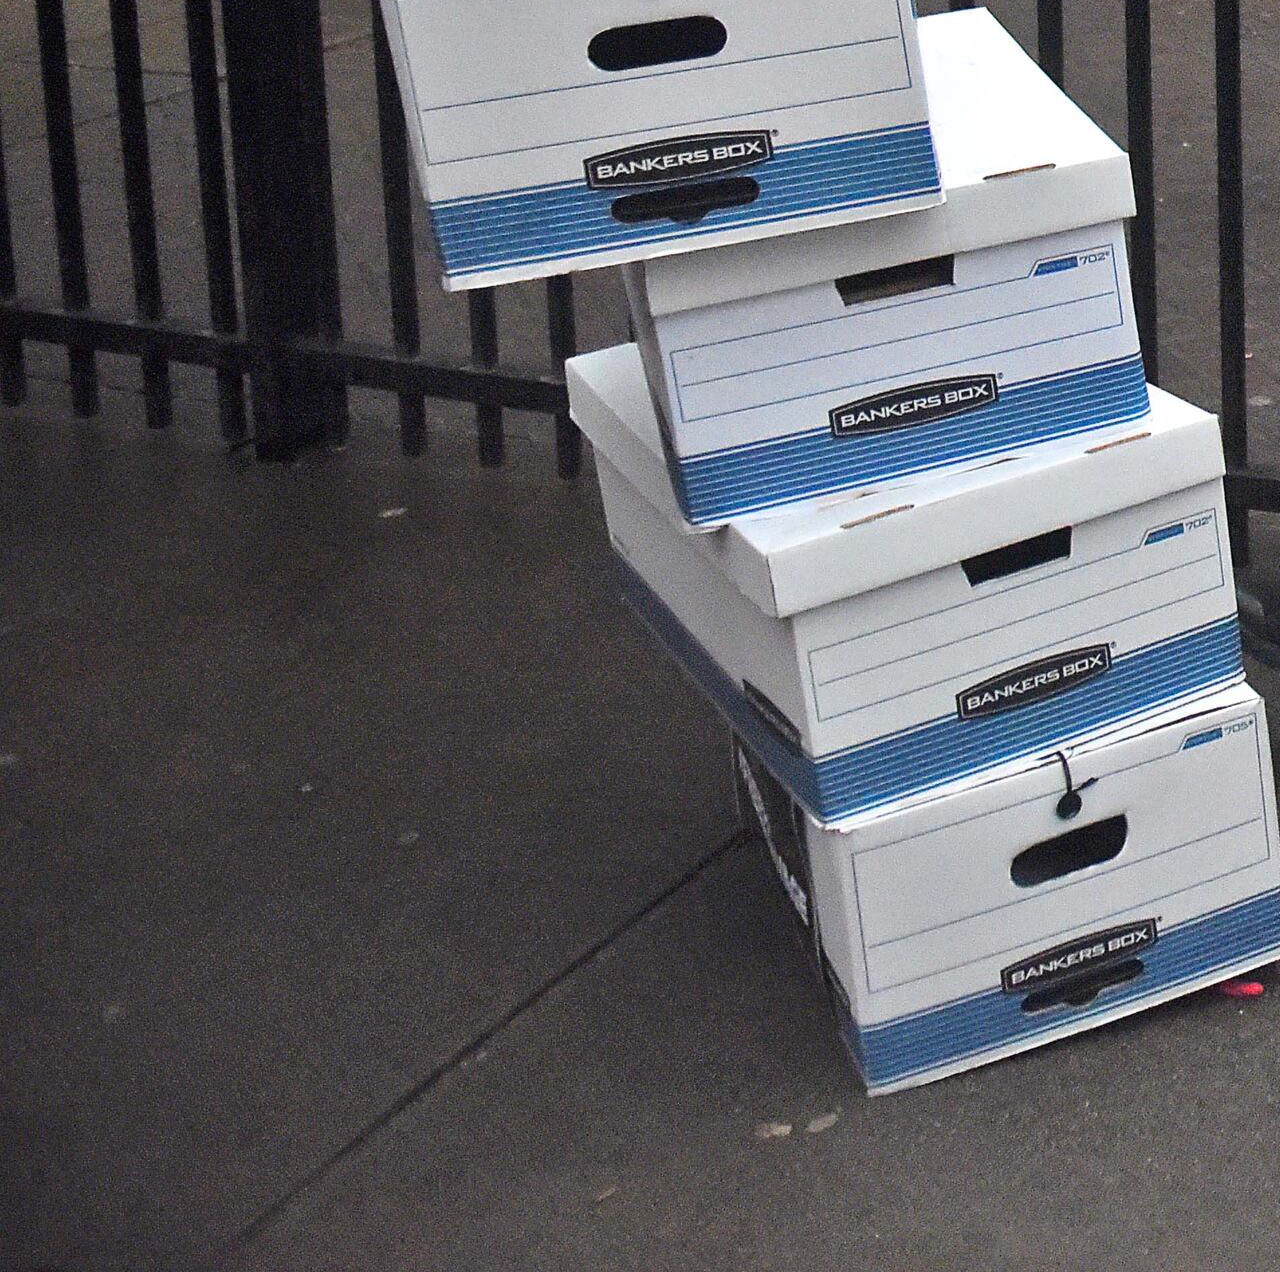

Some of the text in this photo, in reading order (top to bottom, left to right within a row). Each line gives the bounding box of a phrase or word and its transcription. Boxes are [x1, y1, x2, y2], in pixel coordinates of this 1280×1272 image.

[597, 140, 764, 180] BANKERS BOX
[840, 383, 989, 428] BANKERS BOX
[967, 653, 1103, 710] BANKERS BOX
[1011, 928, 1149, 985] BANKERS BOX
